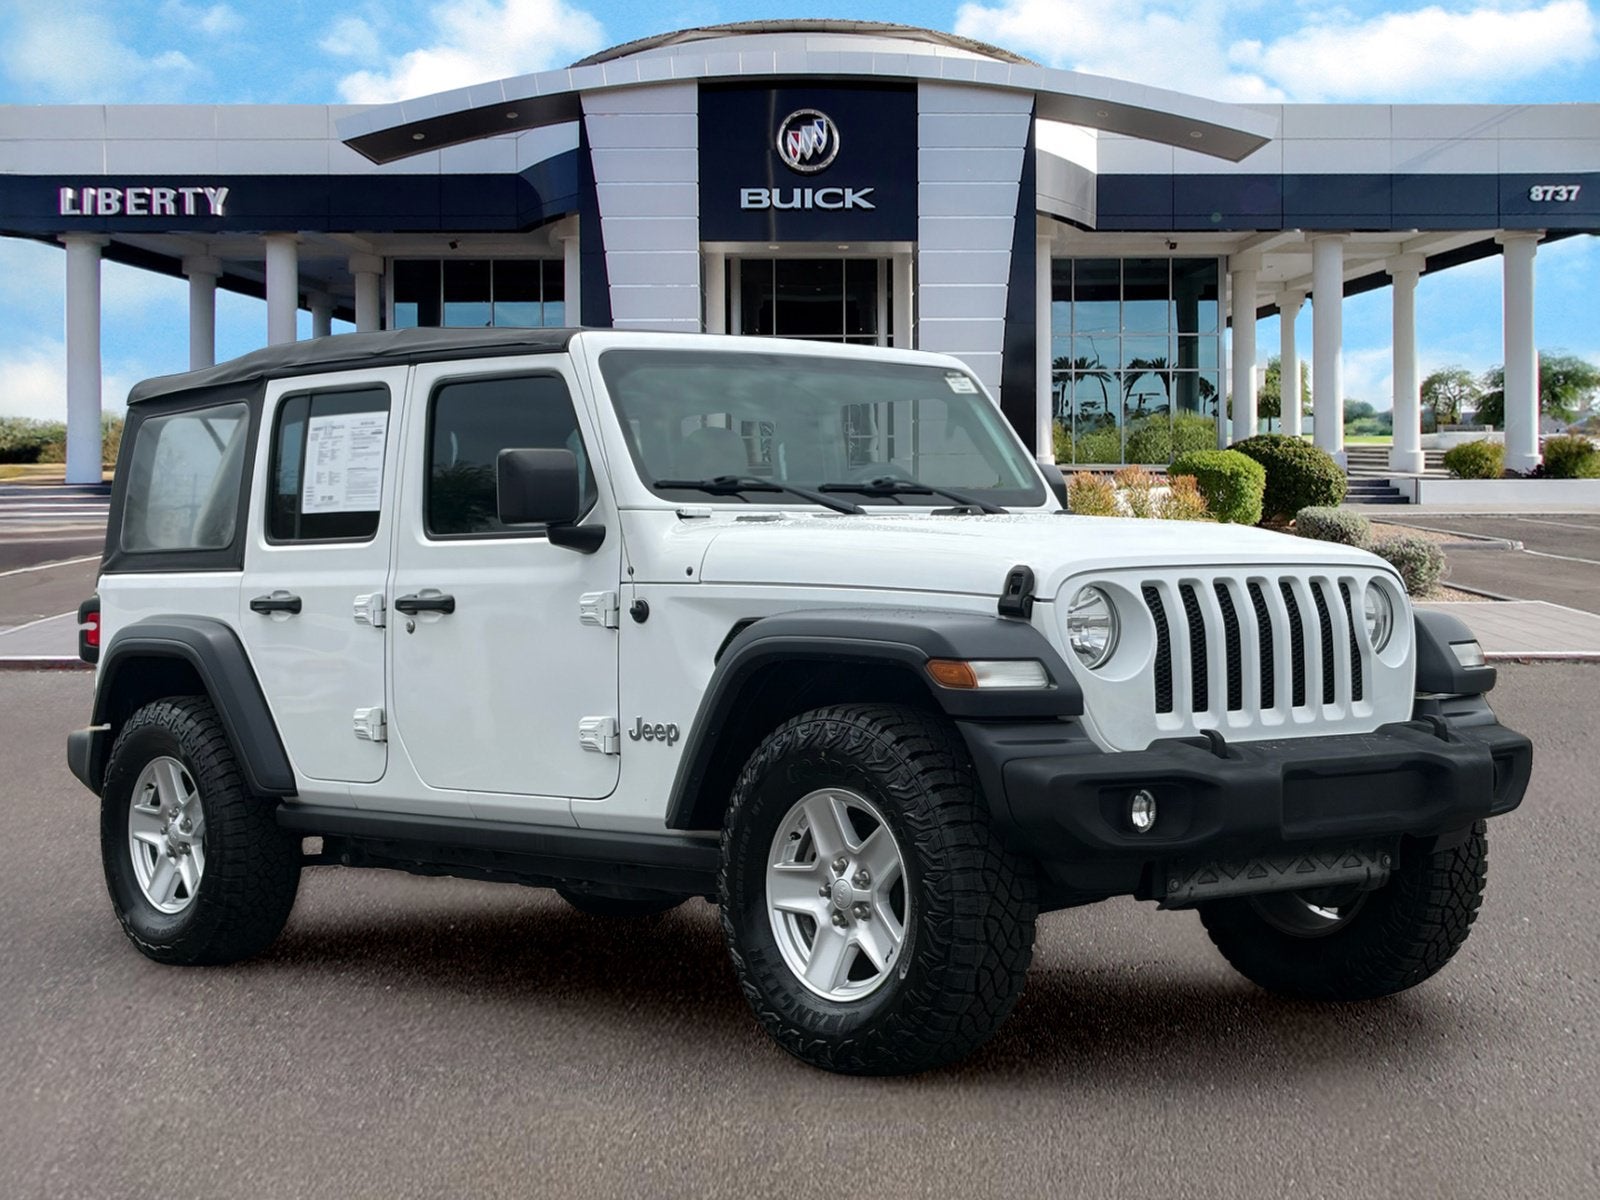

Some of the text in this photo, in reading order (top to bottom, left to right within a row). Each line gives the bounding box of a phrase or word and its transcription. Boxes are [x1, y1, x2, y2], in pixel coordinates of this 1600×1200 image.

[59, 187, 230, 217] LIBERTY
[740, 187, 876, 209] BUICK
[1529, 185, 1581, 202] 8737
[628, 716, 680, 747] Jeep
